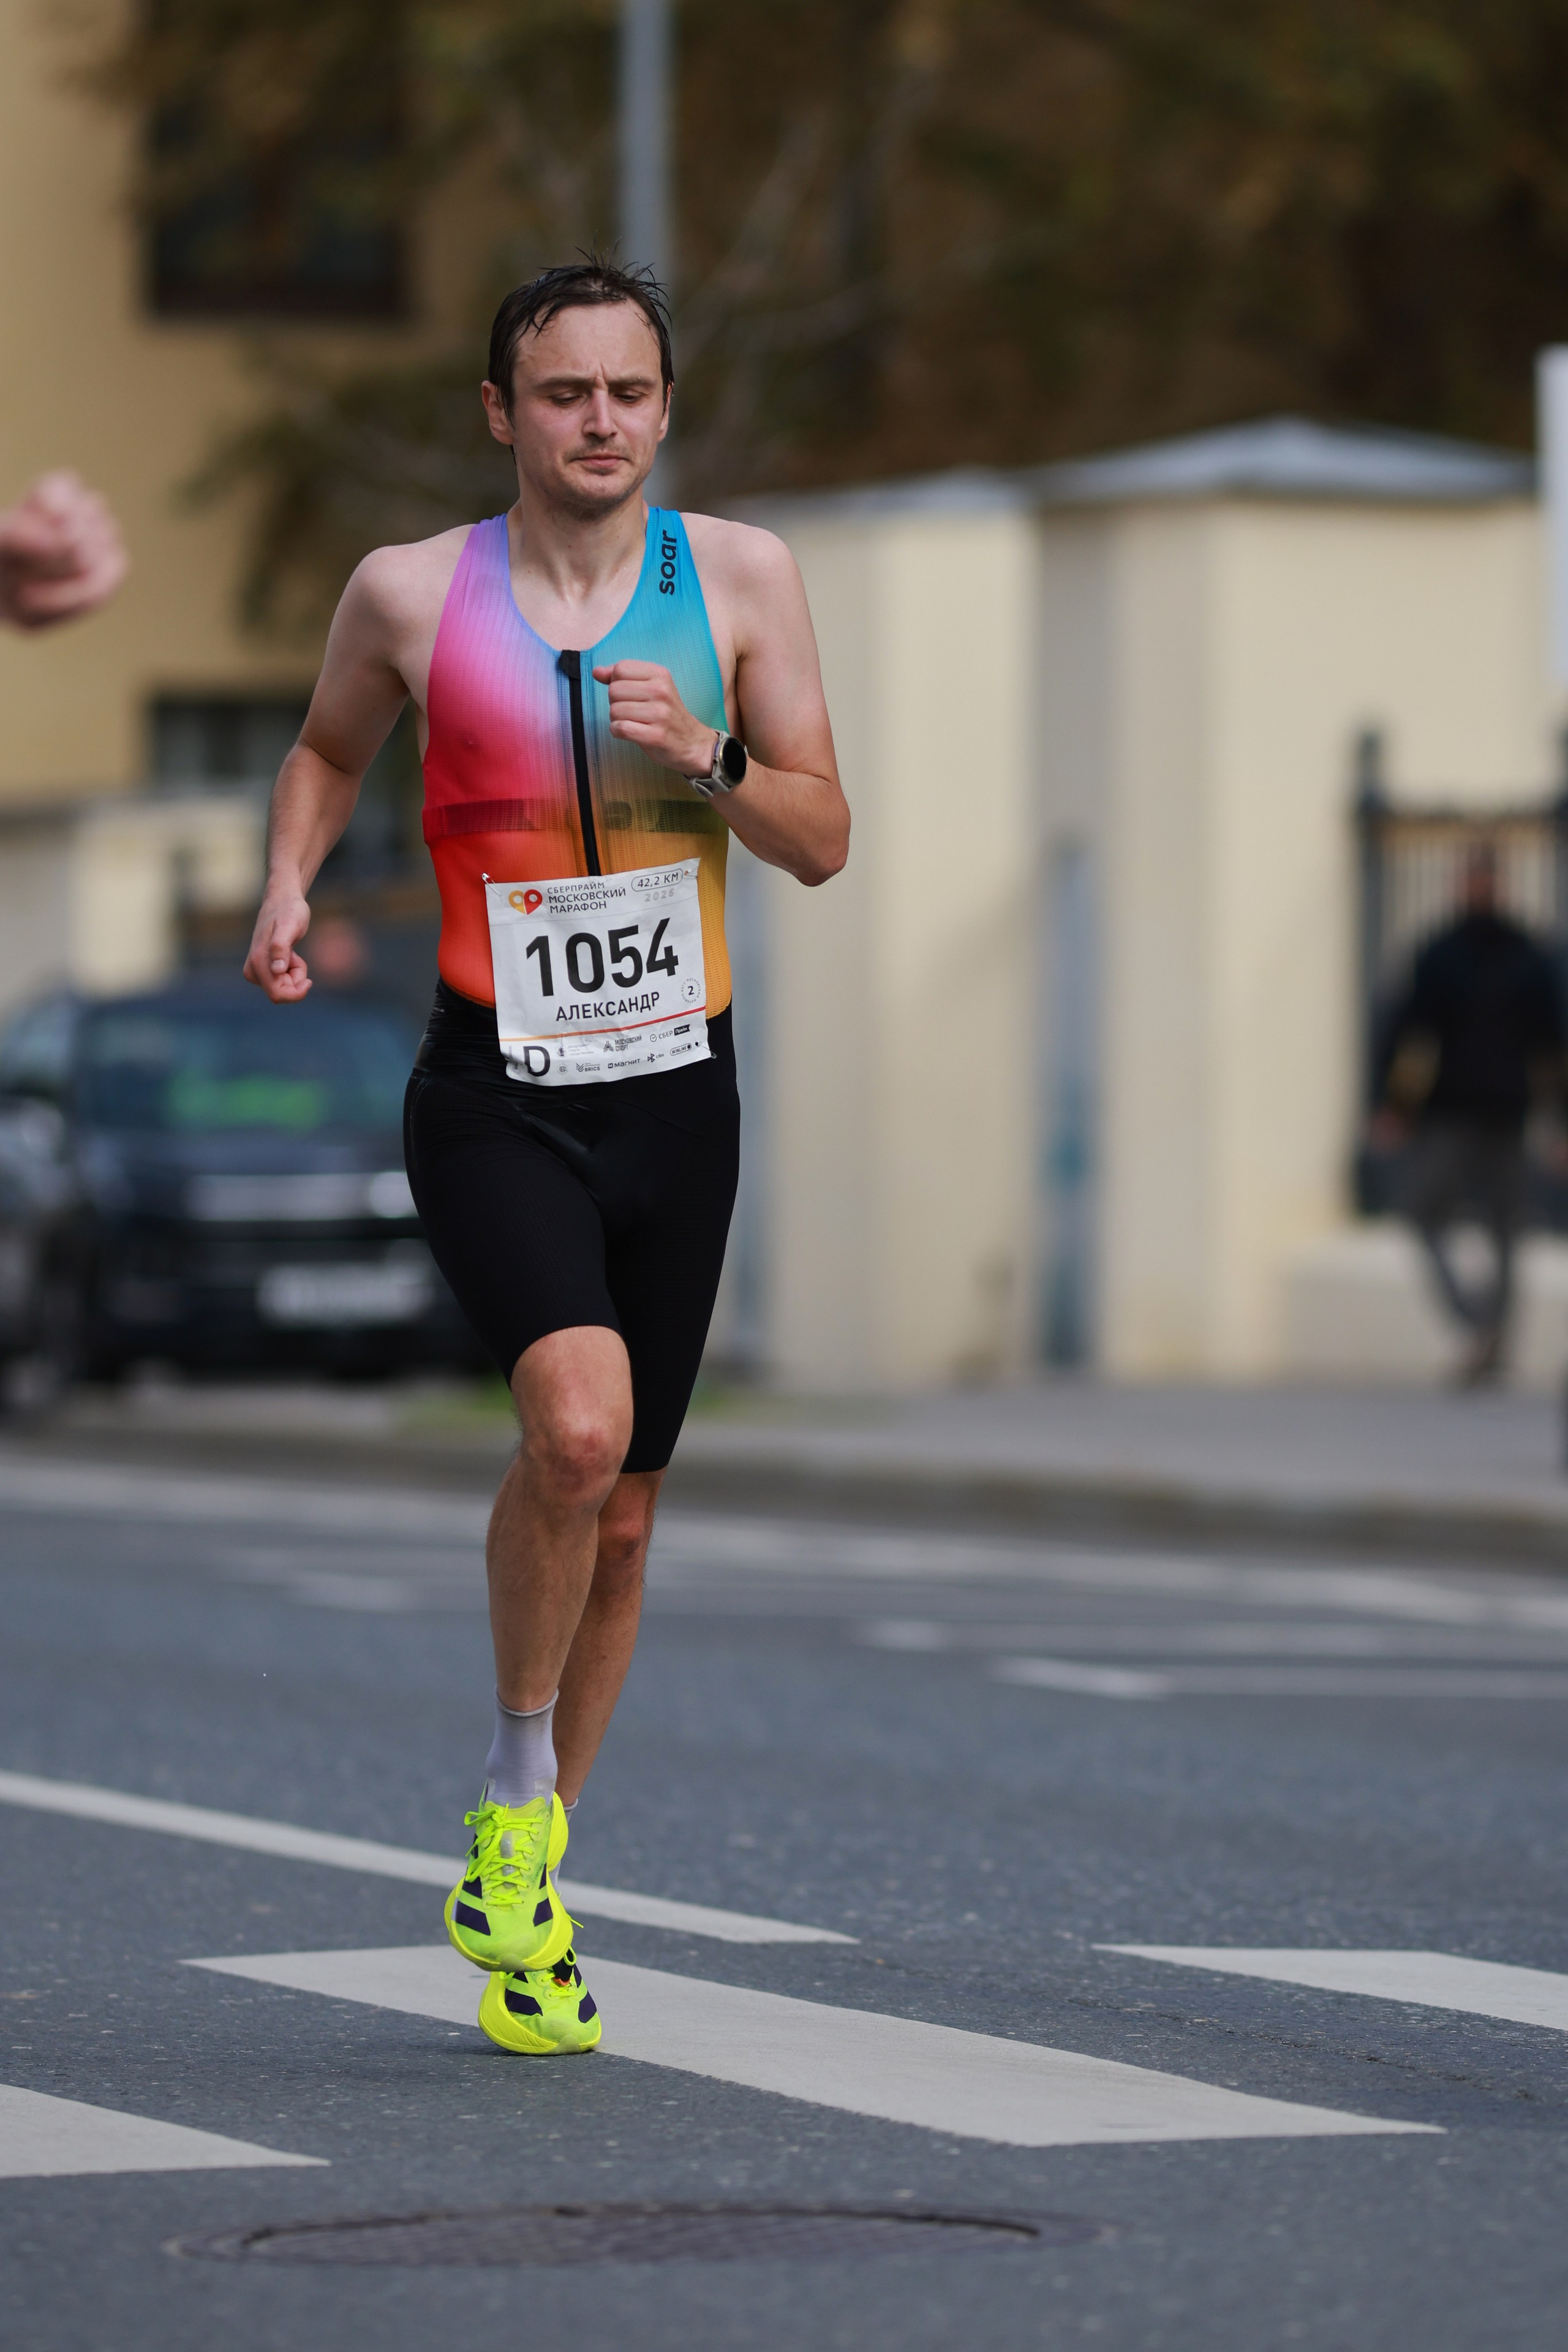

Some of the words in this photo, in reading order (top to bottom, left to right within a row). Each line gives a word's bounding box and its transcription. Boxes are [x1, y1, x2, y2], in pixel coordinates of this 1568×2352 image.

[659, 529, 677, 595] soar
[547, 882, 605, 894] СБЕРПРАЙМ
[638, 876, 660, 888] 42,2
[548, 886, 626, 903] МОСКОВСКИЙ
[550, 900, 607, 914] МАРАФОН
[526, 918, 679, 997] 1054
[687, 985, 695, 995] 2
[556, 991, 660, 1022] АЛЕКСАНДР
[614, 1034, 643, 1045] МОСКОВСКИЙ
[658, 1030, 673, 1039] СБЕР
[671, 1046, 687, 1054] WINLINE
[523, 1046, 551, 1077] D
